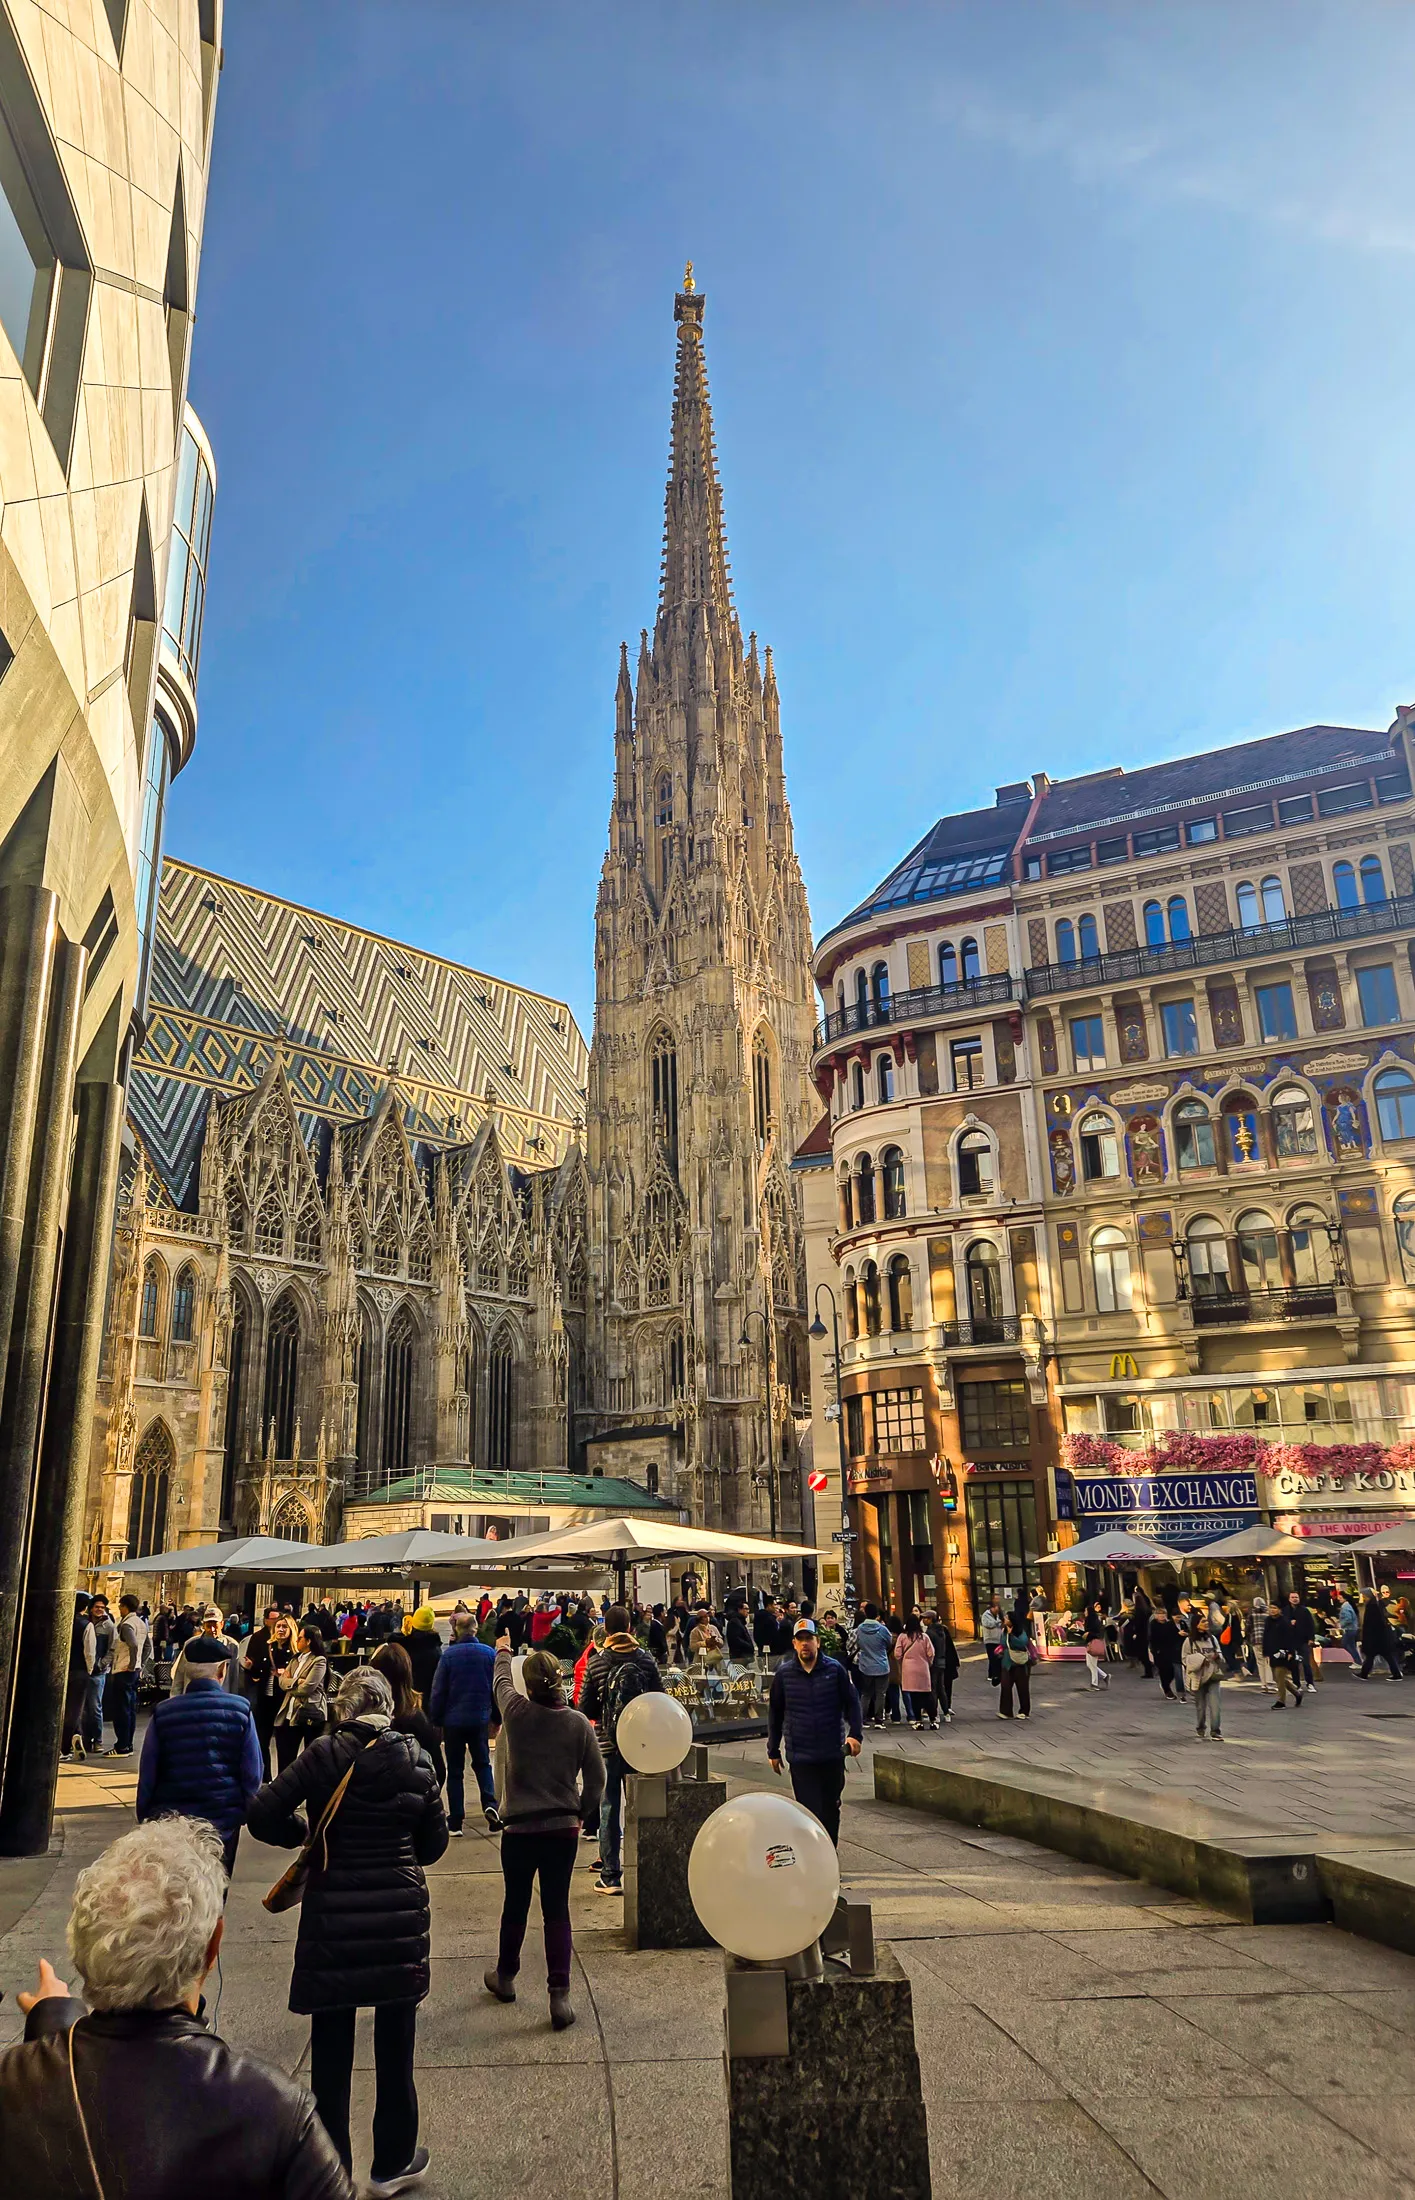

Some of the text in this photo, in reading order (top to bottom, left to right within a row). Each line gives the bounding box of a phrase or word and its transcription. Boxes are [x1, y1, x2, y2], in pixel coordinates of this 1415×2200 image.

[1075, 1483, 1143, 1509] MONEY
[1148, 1479, 1257, 1507] EXCHANGE
[1095, 1520, 1244, 1532] THE CHANGE GROUP
[1319, 1524, 1339, 1533] THE
[665, 1685, 697, 1697] EMEL
[722, 1680, 756, 1692] DEMEL
